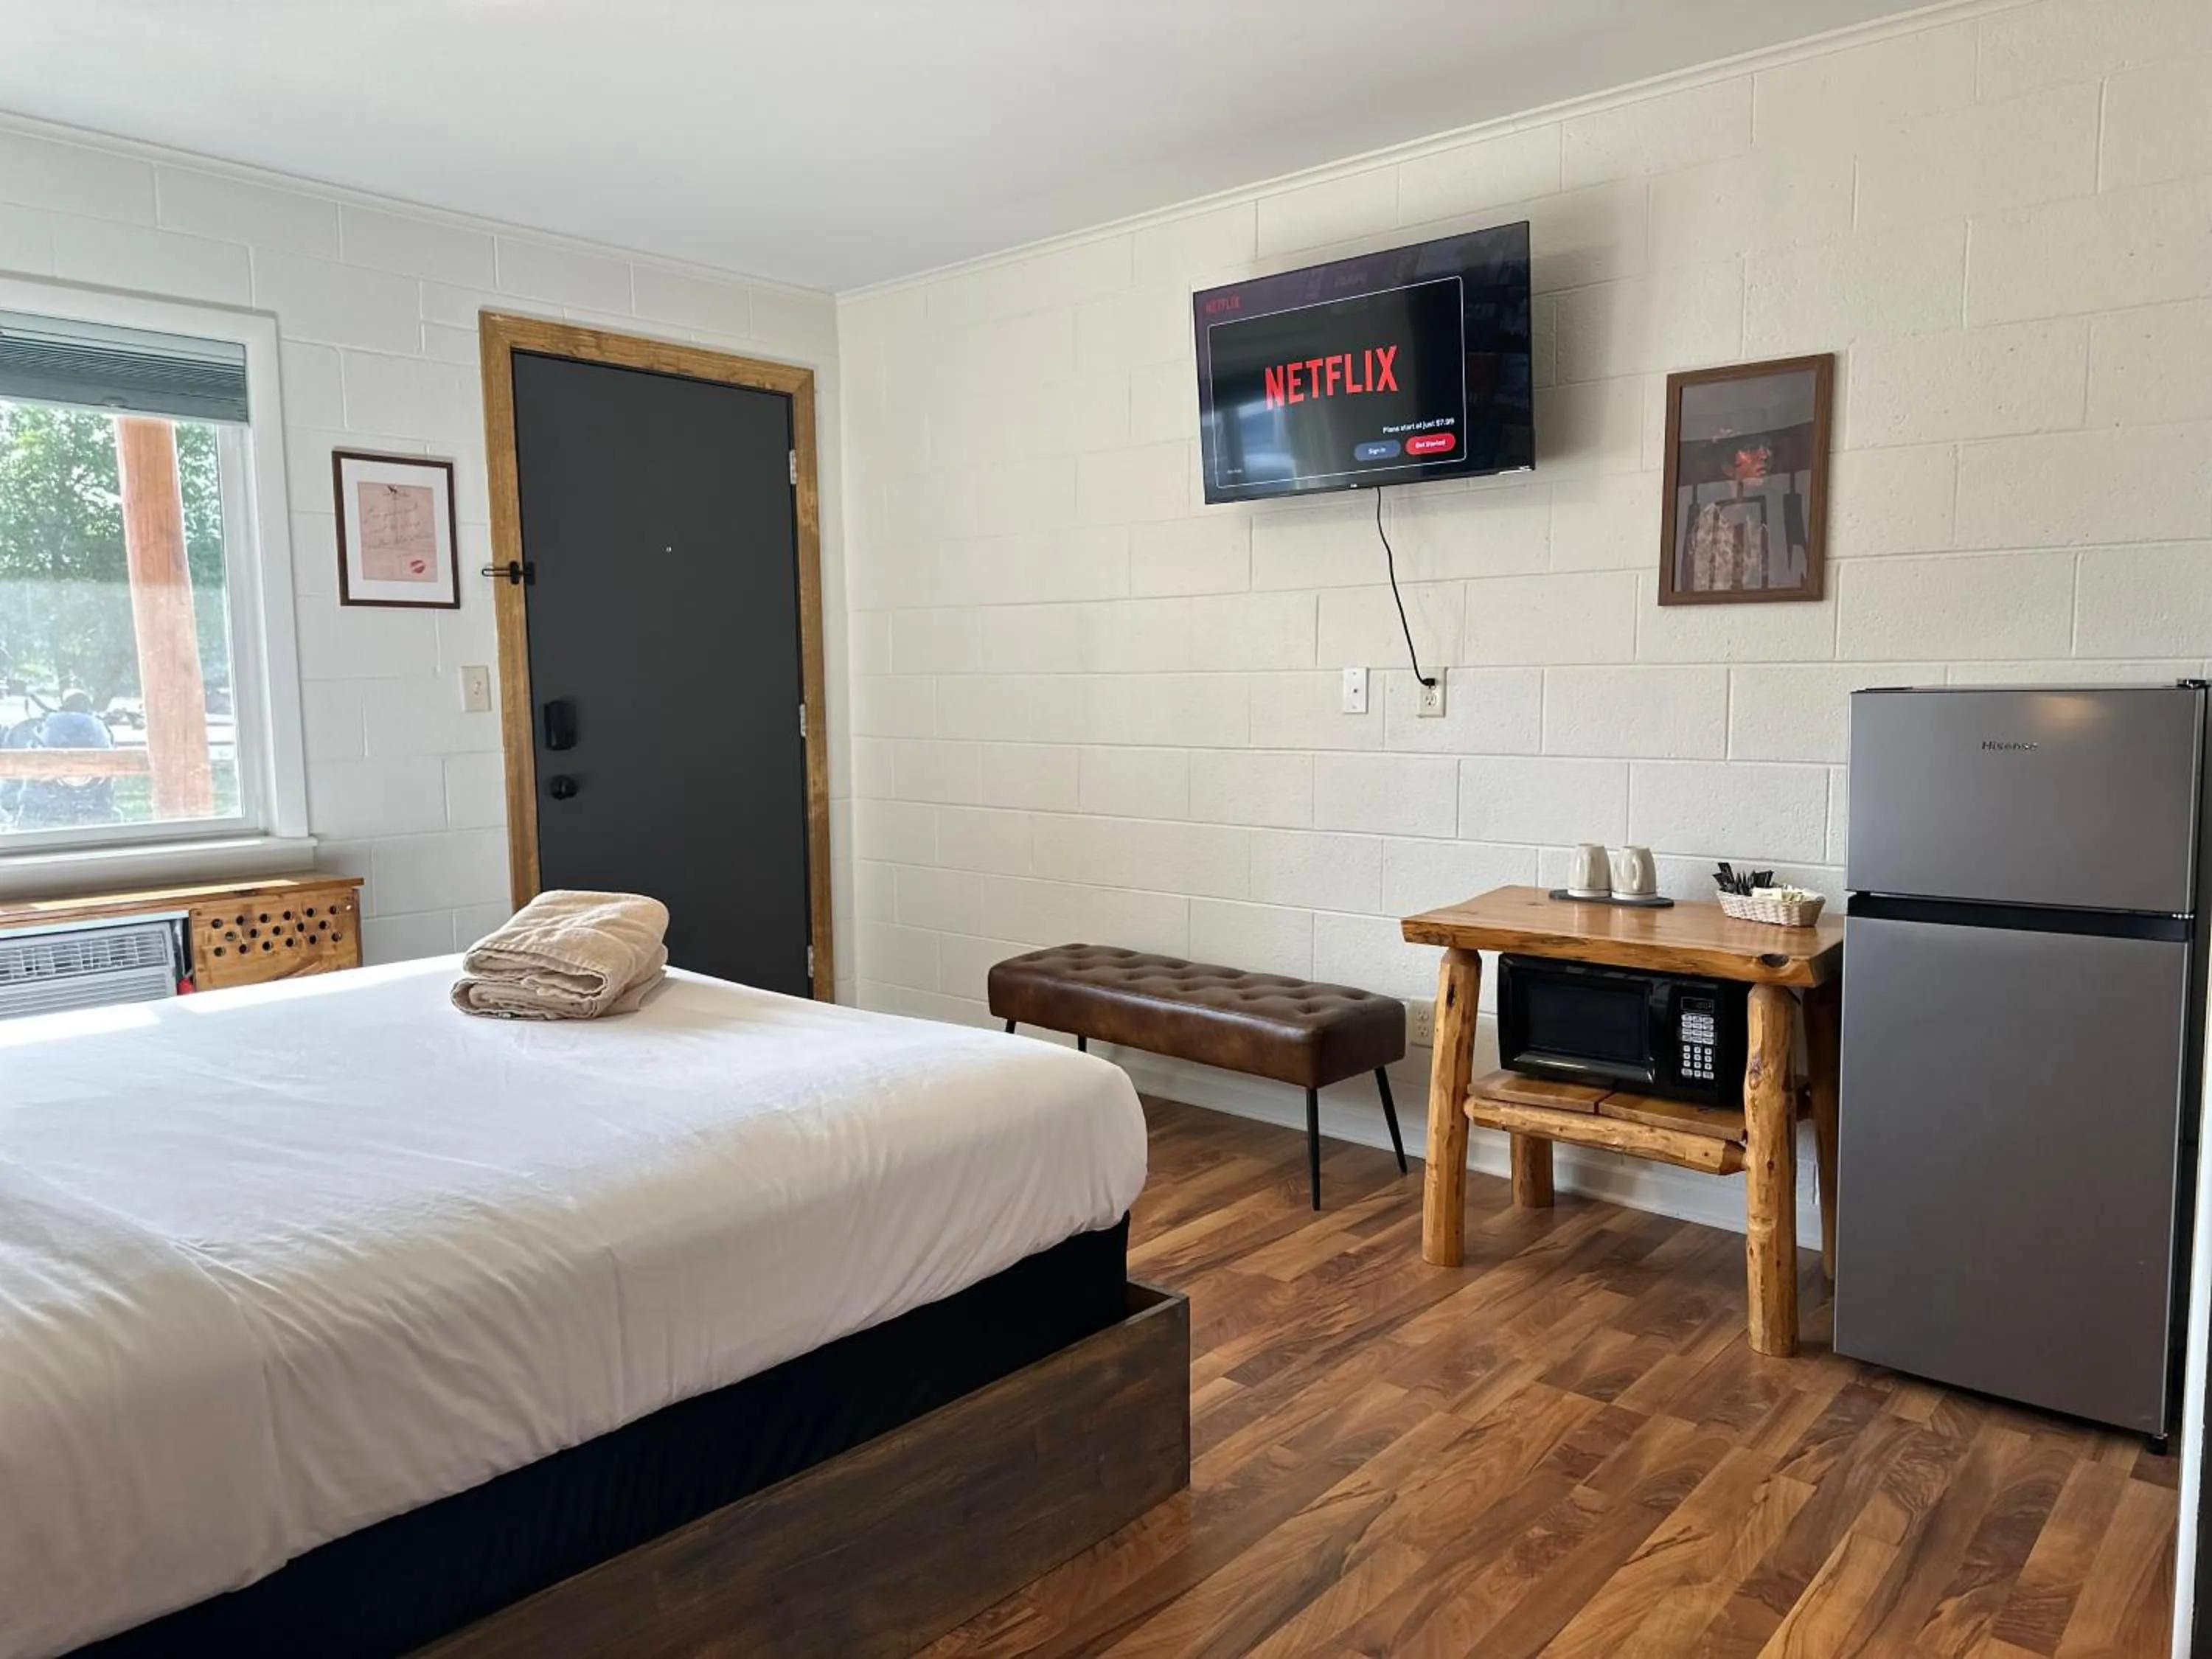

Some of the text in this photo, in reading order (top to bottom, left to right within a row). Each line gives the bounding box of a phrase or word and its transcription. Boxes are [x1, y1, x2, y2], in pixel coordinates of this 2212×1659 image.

[1206, 296, 1239, 313] NETFLIX
[1265, 345, 1399, 411] NETFLIX
[1382, 425, 1399, 434] Plans
[1400, 423, 1414, 431] start
[1415, 421, 1422, 429] at
[1423, 420, 1435, 430] just
[1425, 439, 1446, 448] Started
[1981, 740, 2039, 751] Hisense
